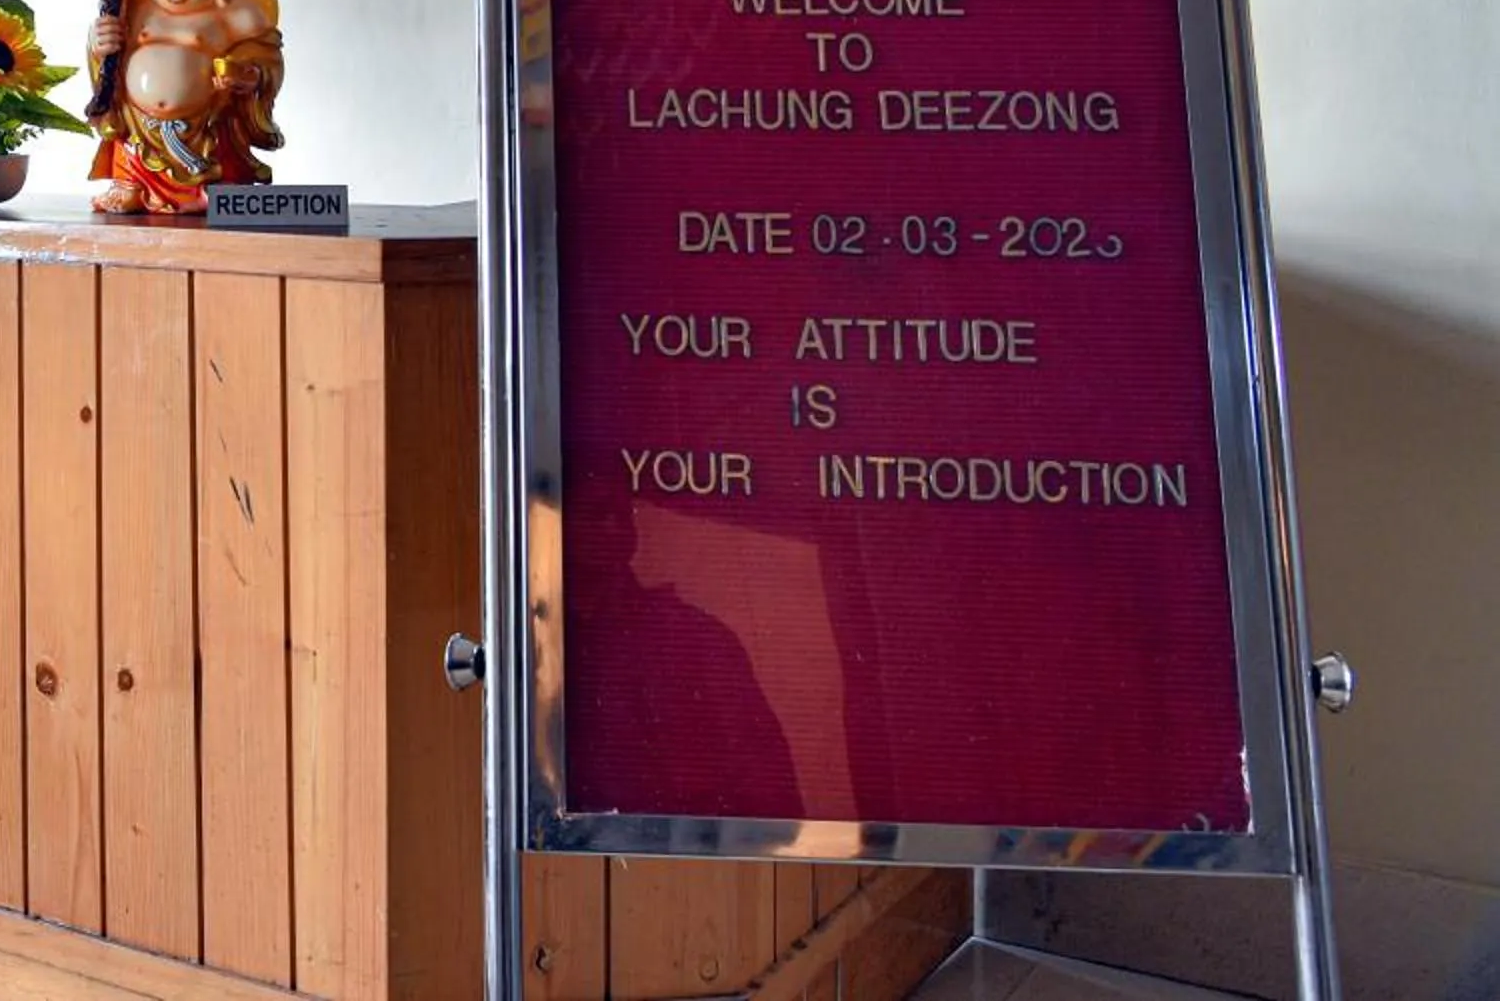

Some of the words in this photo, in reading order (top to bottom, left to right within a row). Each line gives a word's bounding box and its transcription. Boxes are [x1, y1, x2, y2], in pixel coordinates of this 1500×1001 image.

[806, 32, 873, 72] TO
[628, 89, 852, 130] LACHUNG
[878, 90, 1119, 132] DEEZONG
[216, 194, 341, 215] RECEPTION
[679, 211, 794, 254] DATE
[621, 314, 751, 357] YOUR
[795, 318, 1037, 363] ATTITUDE
[791, 385, 836, 429] IS
[622, 449, 751, 495] YOUR
[819, 455, 1187, 506] INTRODUCTION
